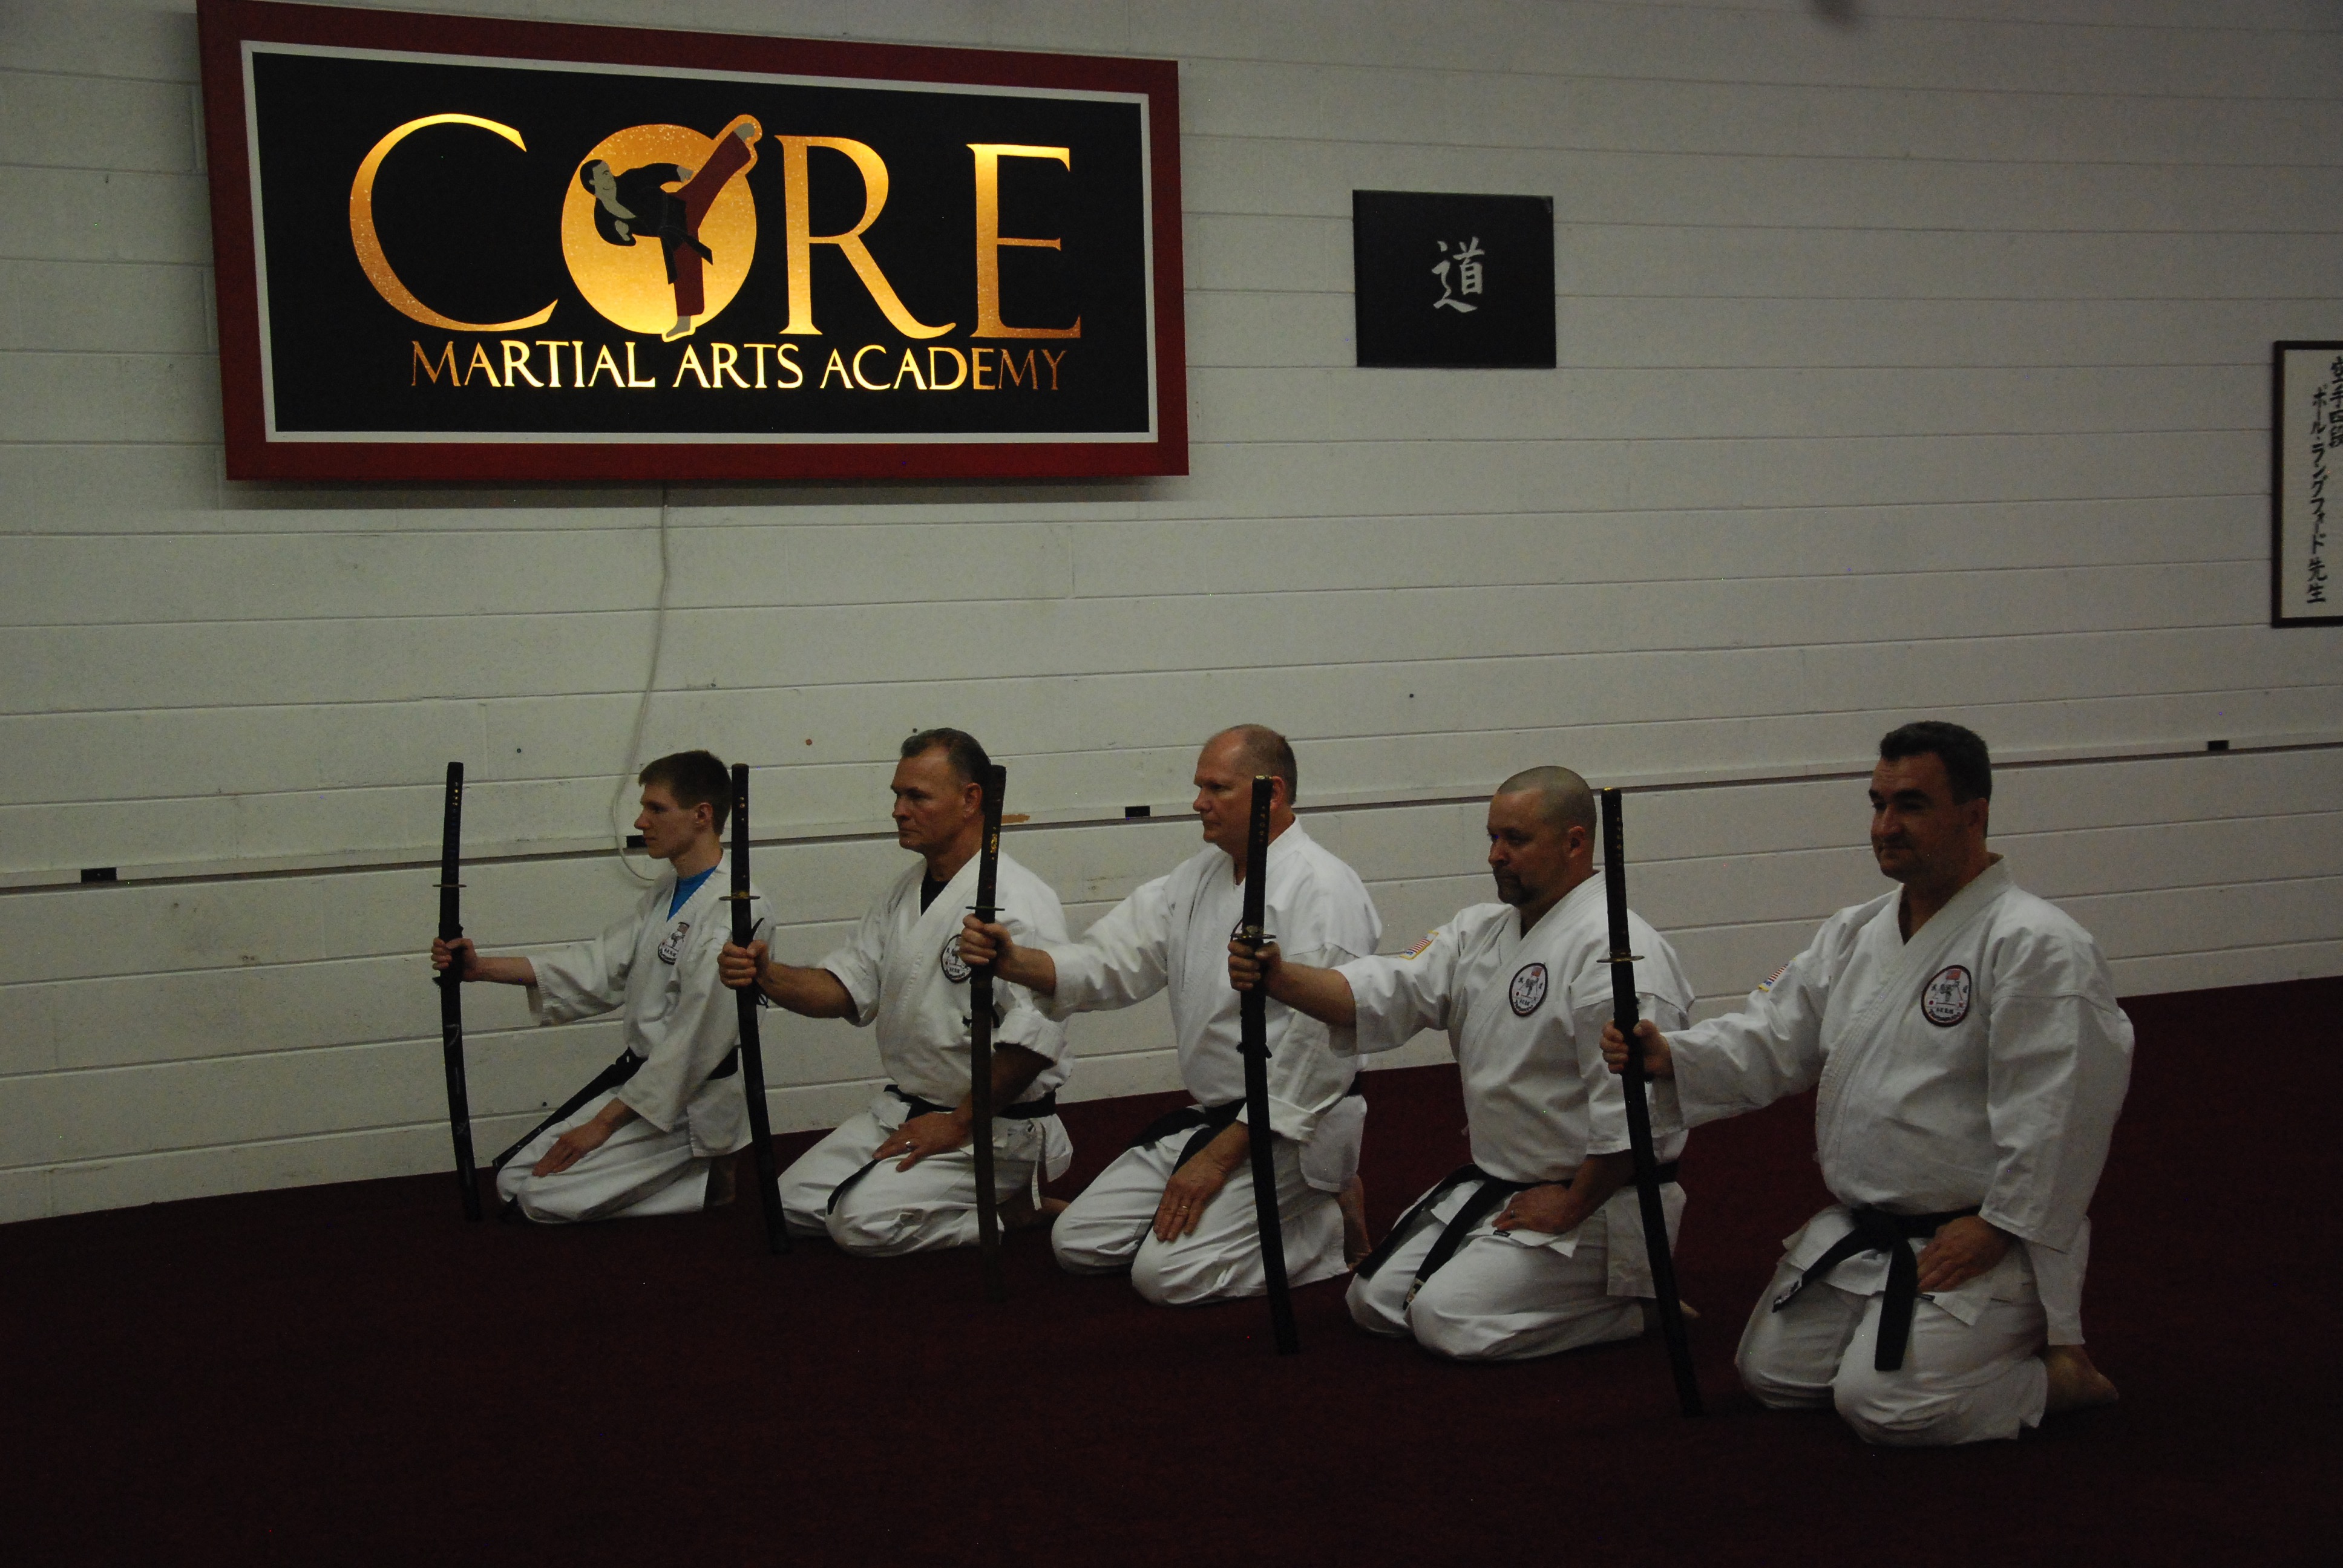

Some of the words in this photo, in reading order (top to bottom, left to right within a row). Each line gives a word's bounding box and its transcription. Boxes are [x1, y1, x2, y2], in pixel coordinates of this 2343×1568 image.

[349, 113, 1081, 342] CORE
[1432, 236, 1485, 313] 道
[411, 339, 655, 388] MARTIAL
[672, 342, 804, 389] ARTS
[820, 344, 1066, 391] ACADEMY
